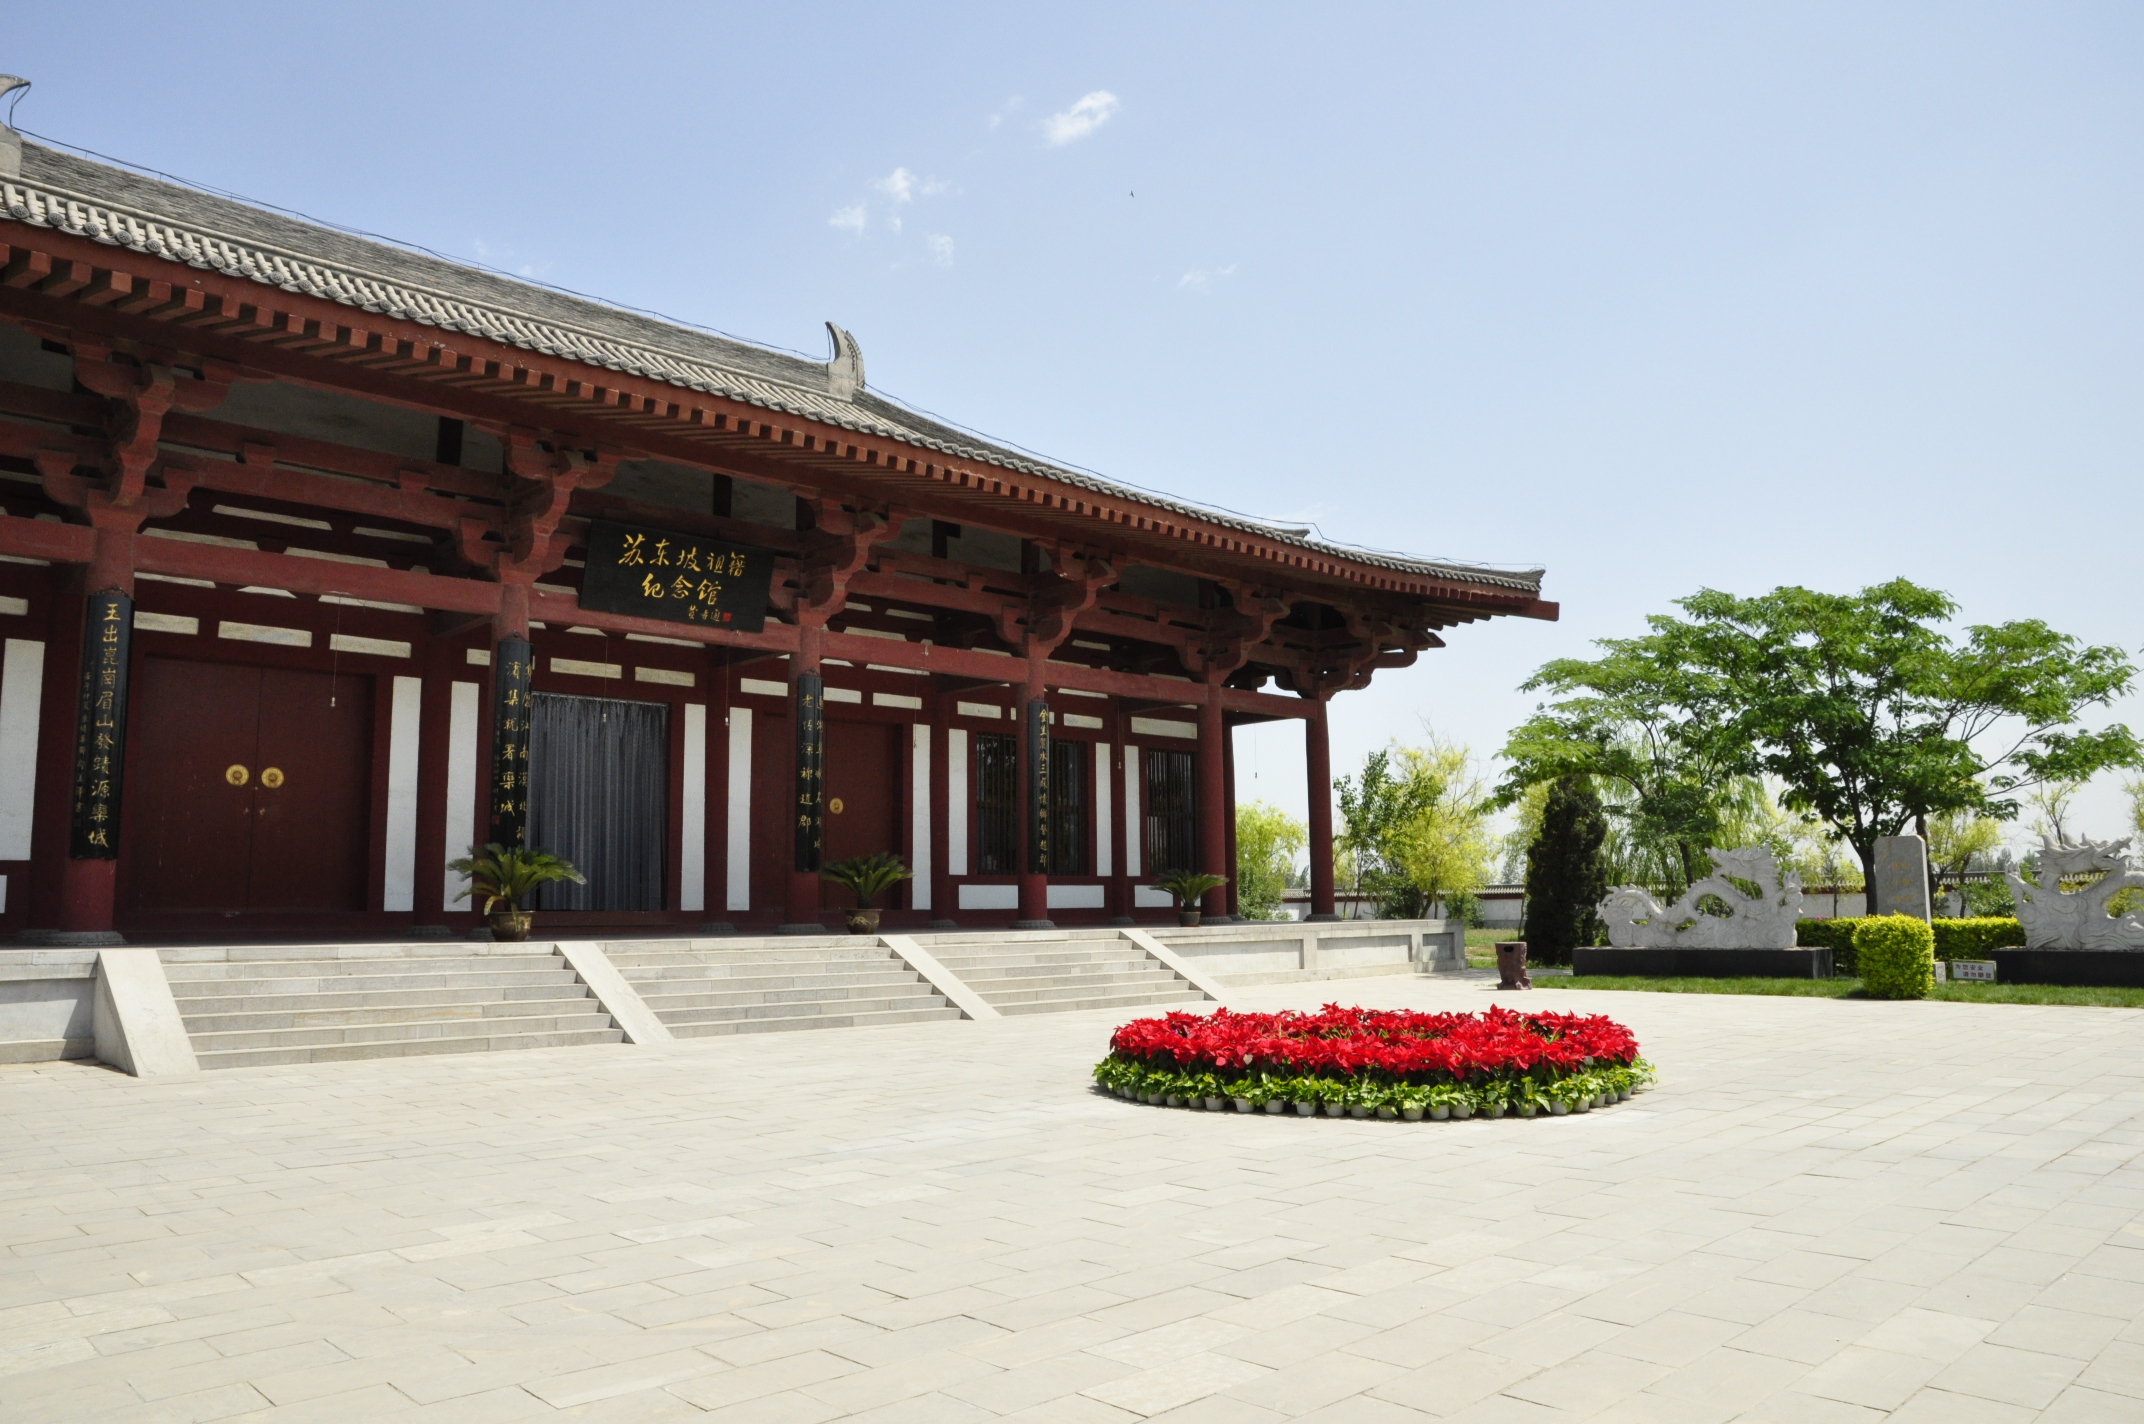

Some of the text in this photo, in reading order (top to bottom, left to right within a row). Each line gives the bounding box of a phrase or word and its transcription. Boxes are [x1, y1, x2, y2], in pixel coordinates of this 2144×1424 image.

[618, 533, 746, 577] 苏东坡祖籍
[641, 573, 722, 606] 纪念馆
[1962, 971, 1992, 979] 请勿攀登
